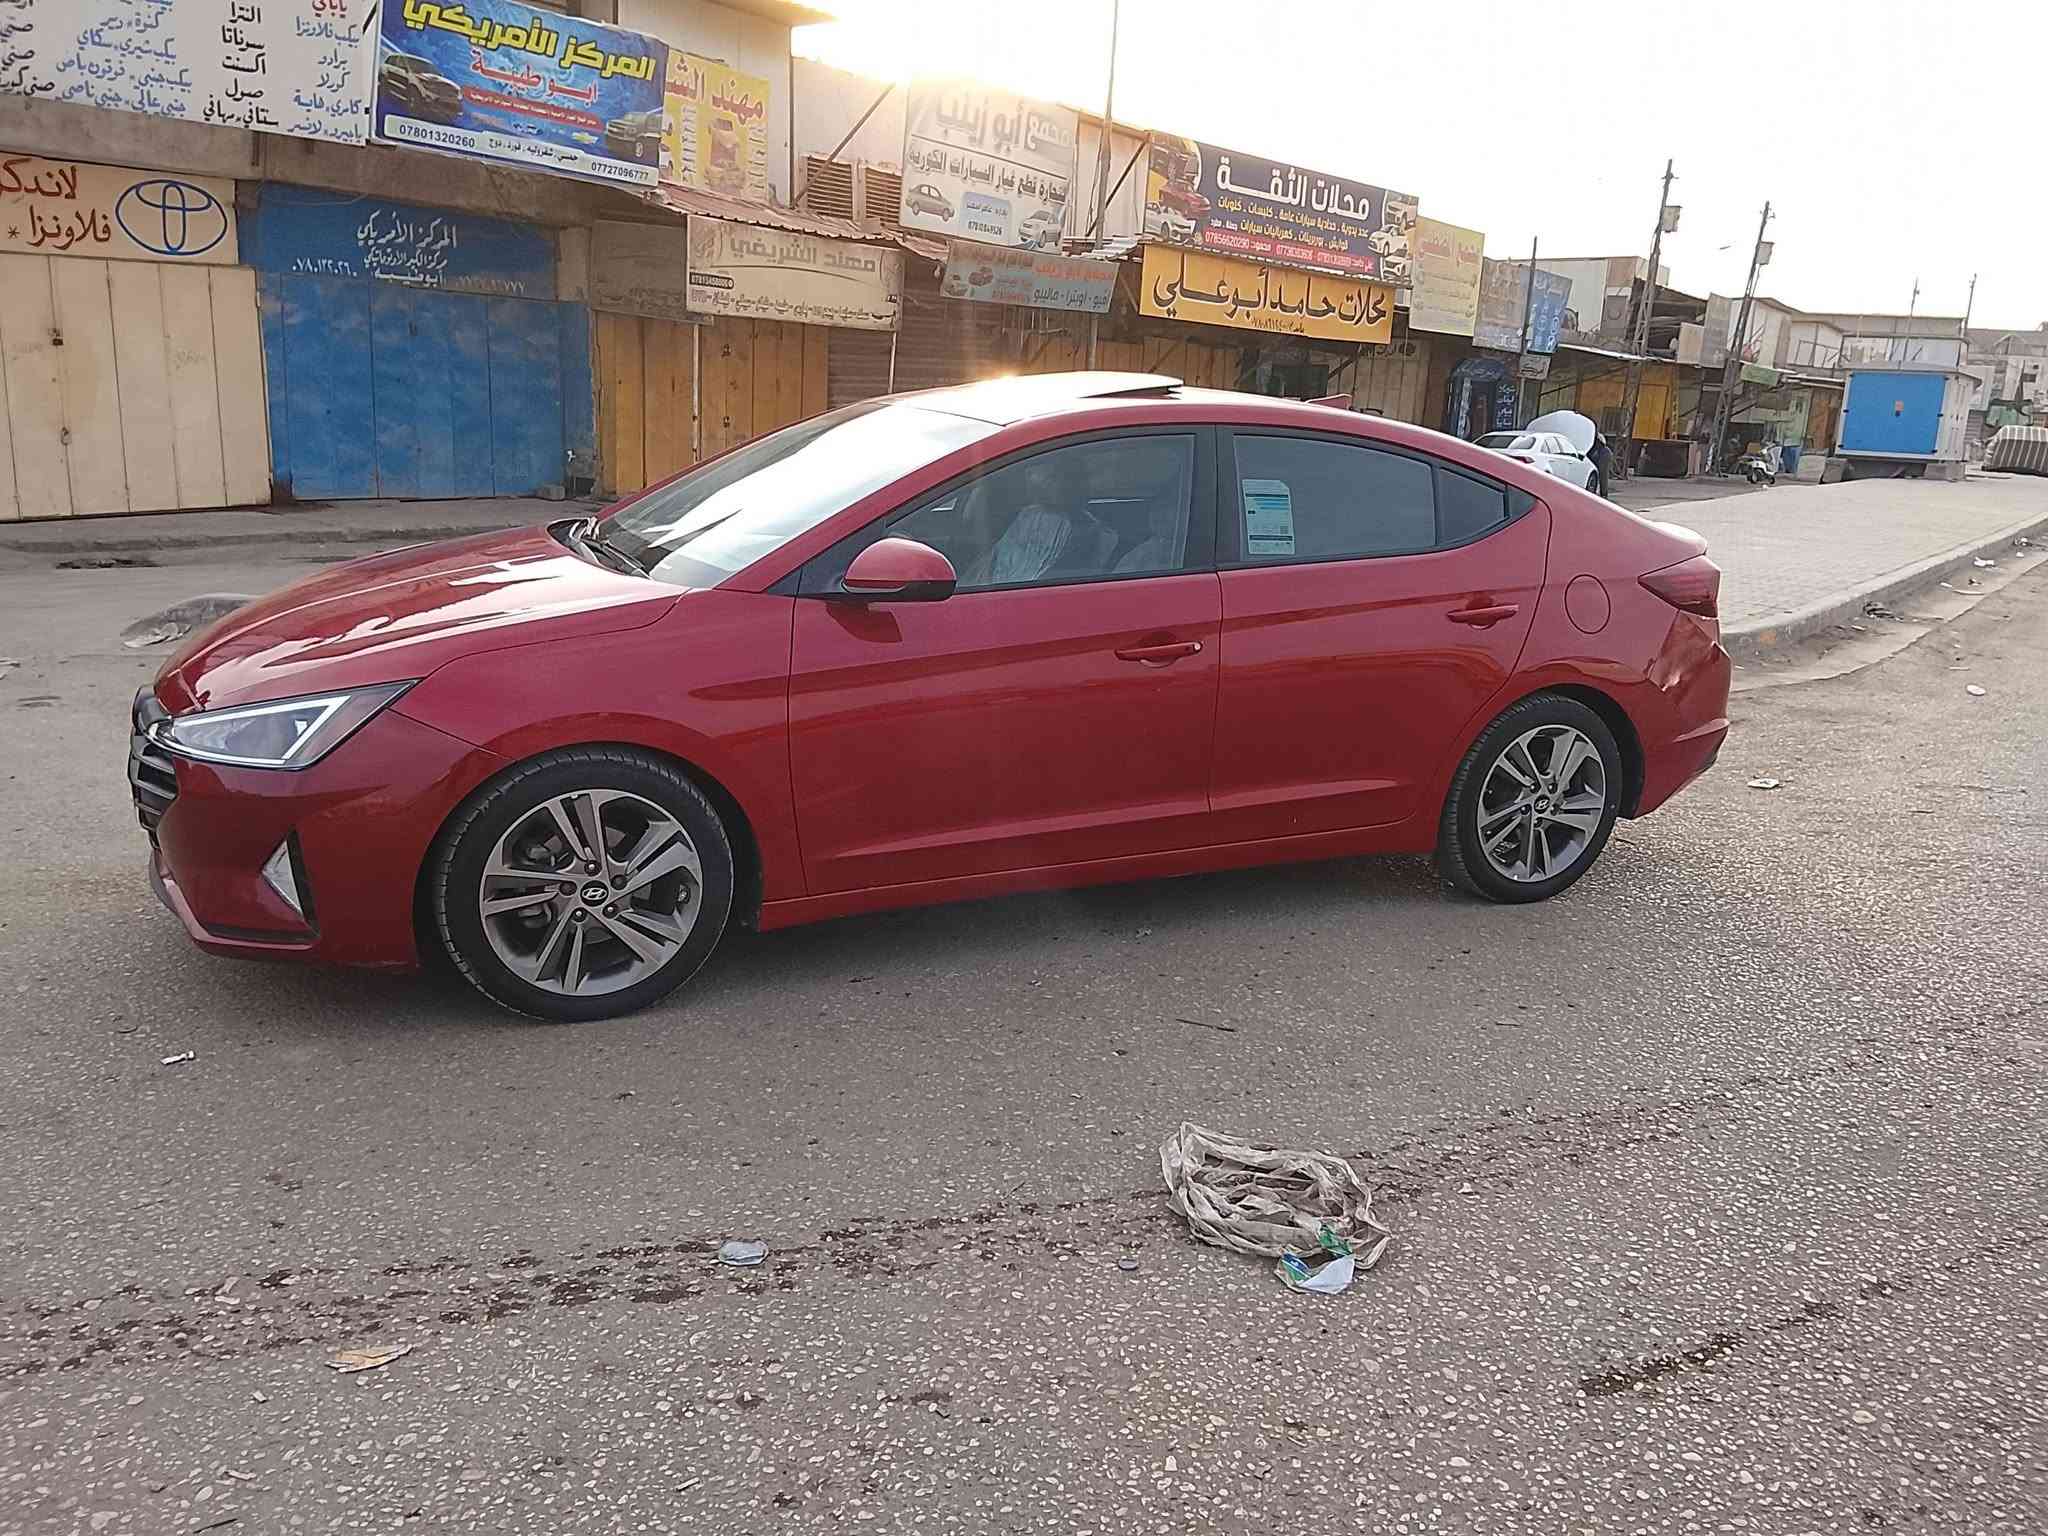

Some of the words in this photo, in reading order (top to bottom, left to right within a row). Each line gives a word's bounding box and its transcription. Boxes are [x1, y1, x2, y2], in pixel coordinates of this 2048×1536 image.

[222, 25, 265, 51] سوناتا
[403, 0, 557, 58] الأمريكي
[222, 52, 266, 74] اكسنت
[559, 38, 658, 82] المركز
[225, 78, 265, 102] صول
[399, 124, 476, 148] 07801320260
[0, 157, 79, 200] لاندك
[1216, 155, 1308, 208] الثقة
[1311, 179, 1370, 221] محلات
[26, 203, 113, 250] فلاونزا
[356, 208, 415, 247] الأمريكي
[415, 217, 457, 250] المركز
[1269, 275, 1338, 319] حامد
